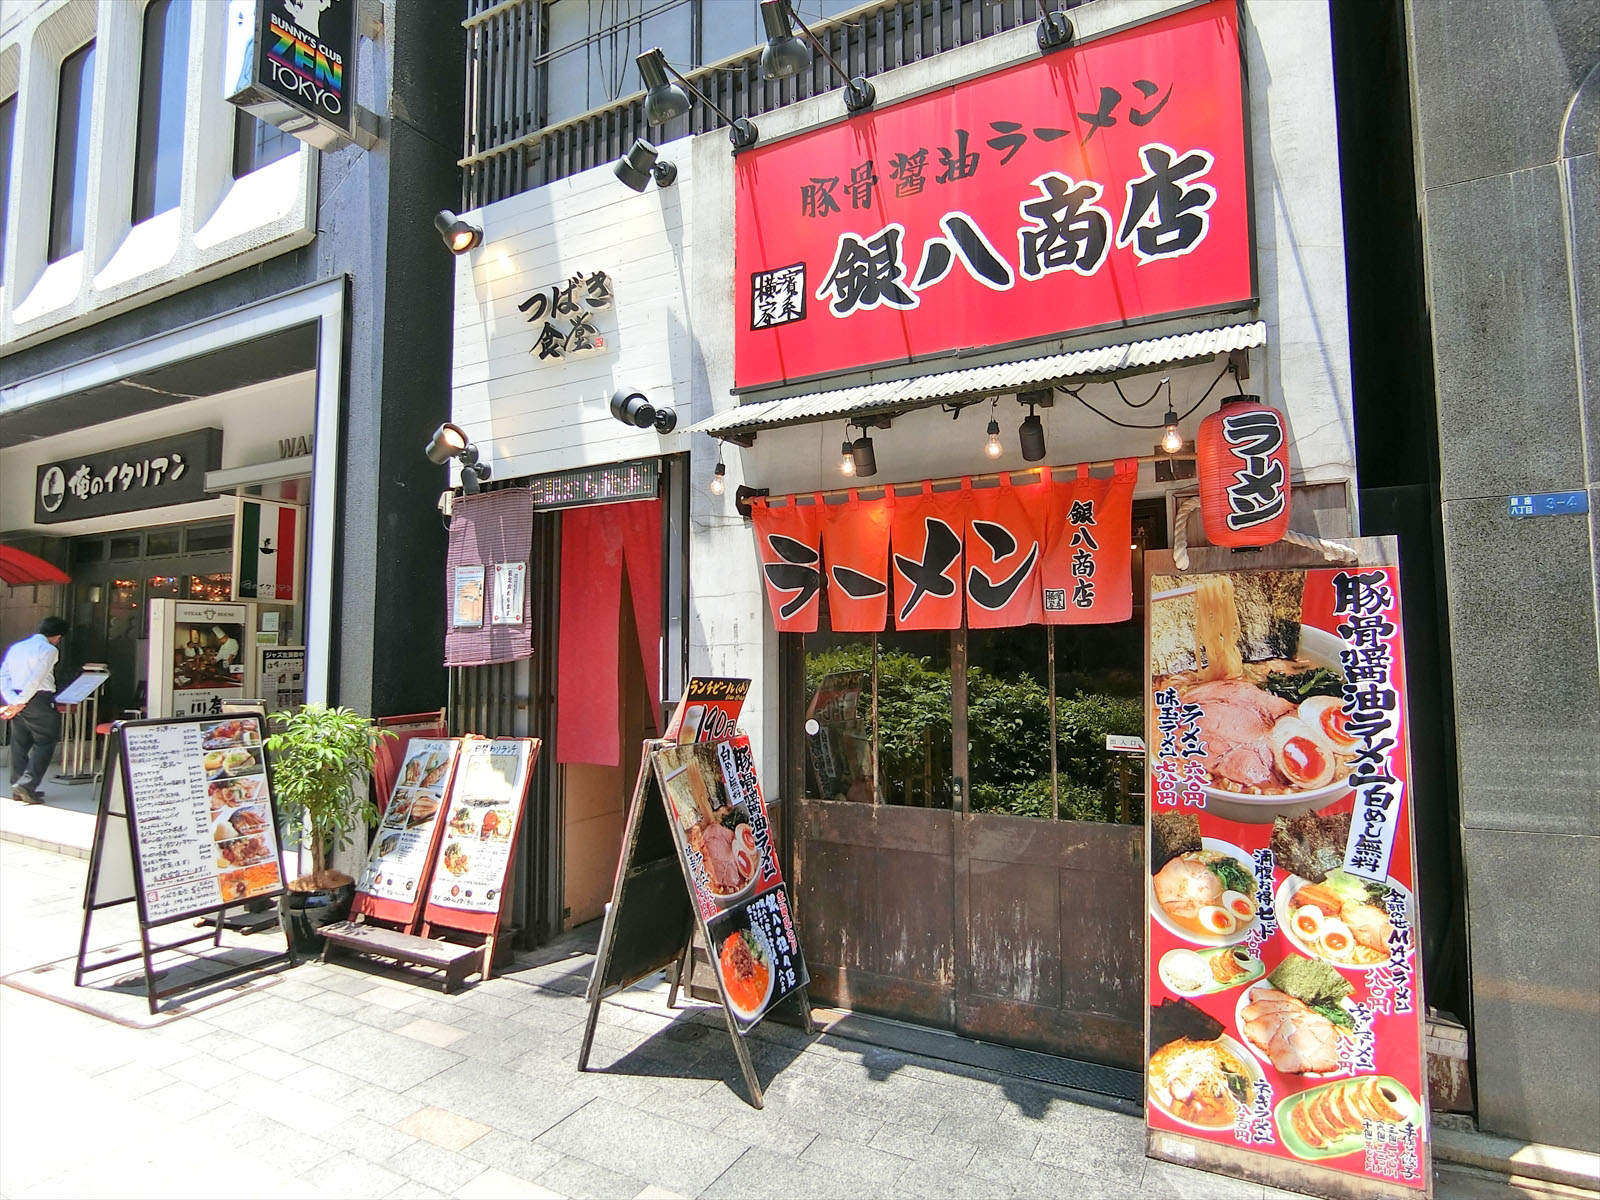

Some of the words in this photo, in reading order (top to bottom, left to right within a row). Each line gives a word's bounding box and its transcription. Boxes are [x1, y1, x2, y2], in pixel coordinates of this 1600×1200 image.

[266, 21, 343, 98] ZEN
[268, 58, 342, 114] TOKYO
[271, 13, 317, 49] BUNNY'S
[318, 43, 343, 65] CLUB
[801, 79, 1173, 218] 豚骨醤油ラーメン
[815, 143, 1218, 319] 銀八商店
[518, 271, 611, 322] つばき
[529, 312, 596, 360] 食堂
[68, 453, 186, 499] 俺のイタリアン
[1222, 411, 1286, 531] ラーメン
[764, 517, 1039, 621] ラーメン
[1066, 499, 1099, 609] 銀八商店
[1332, 570, 1398, 788] 豚骨醤油ラーメン
[732, 744, 777, 882] 豚骨醤油ラーメン
